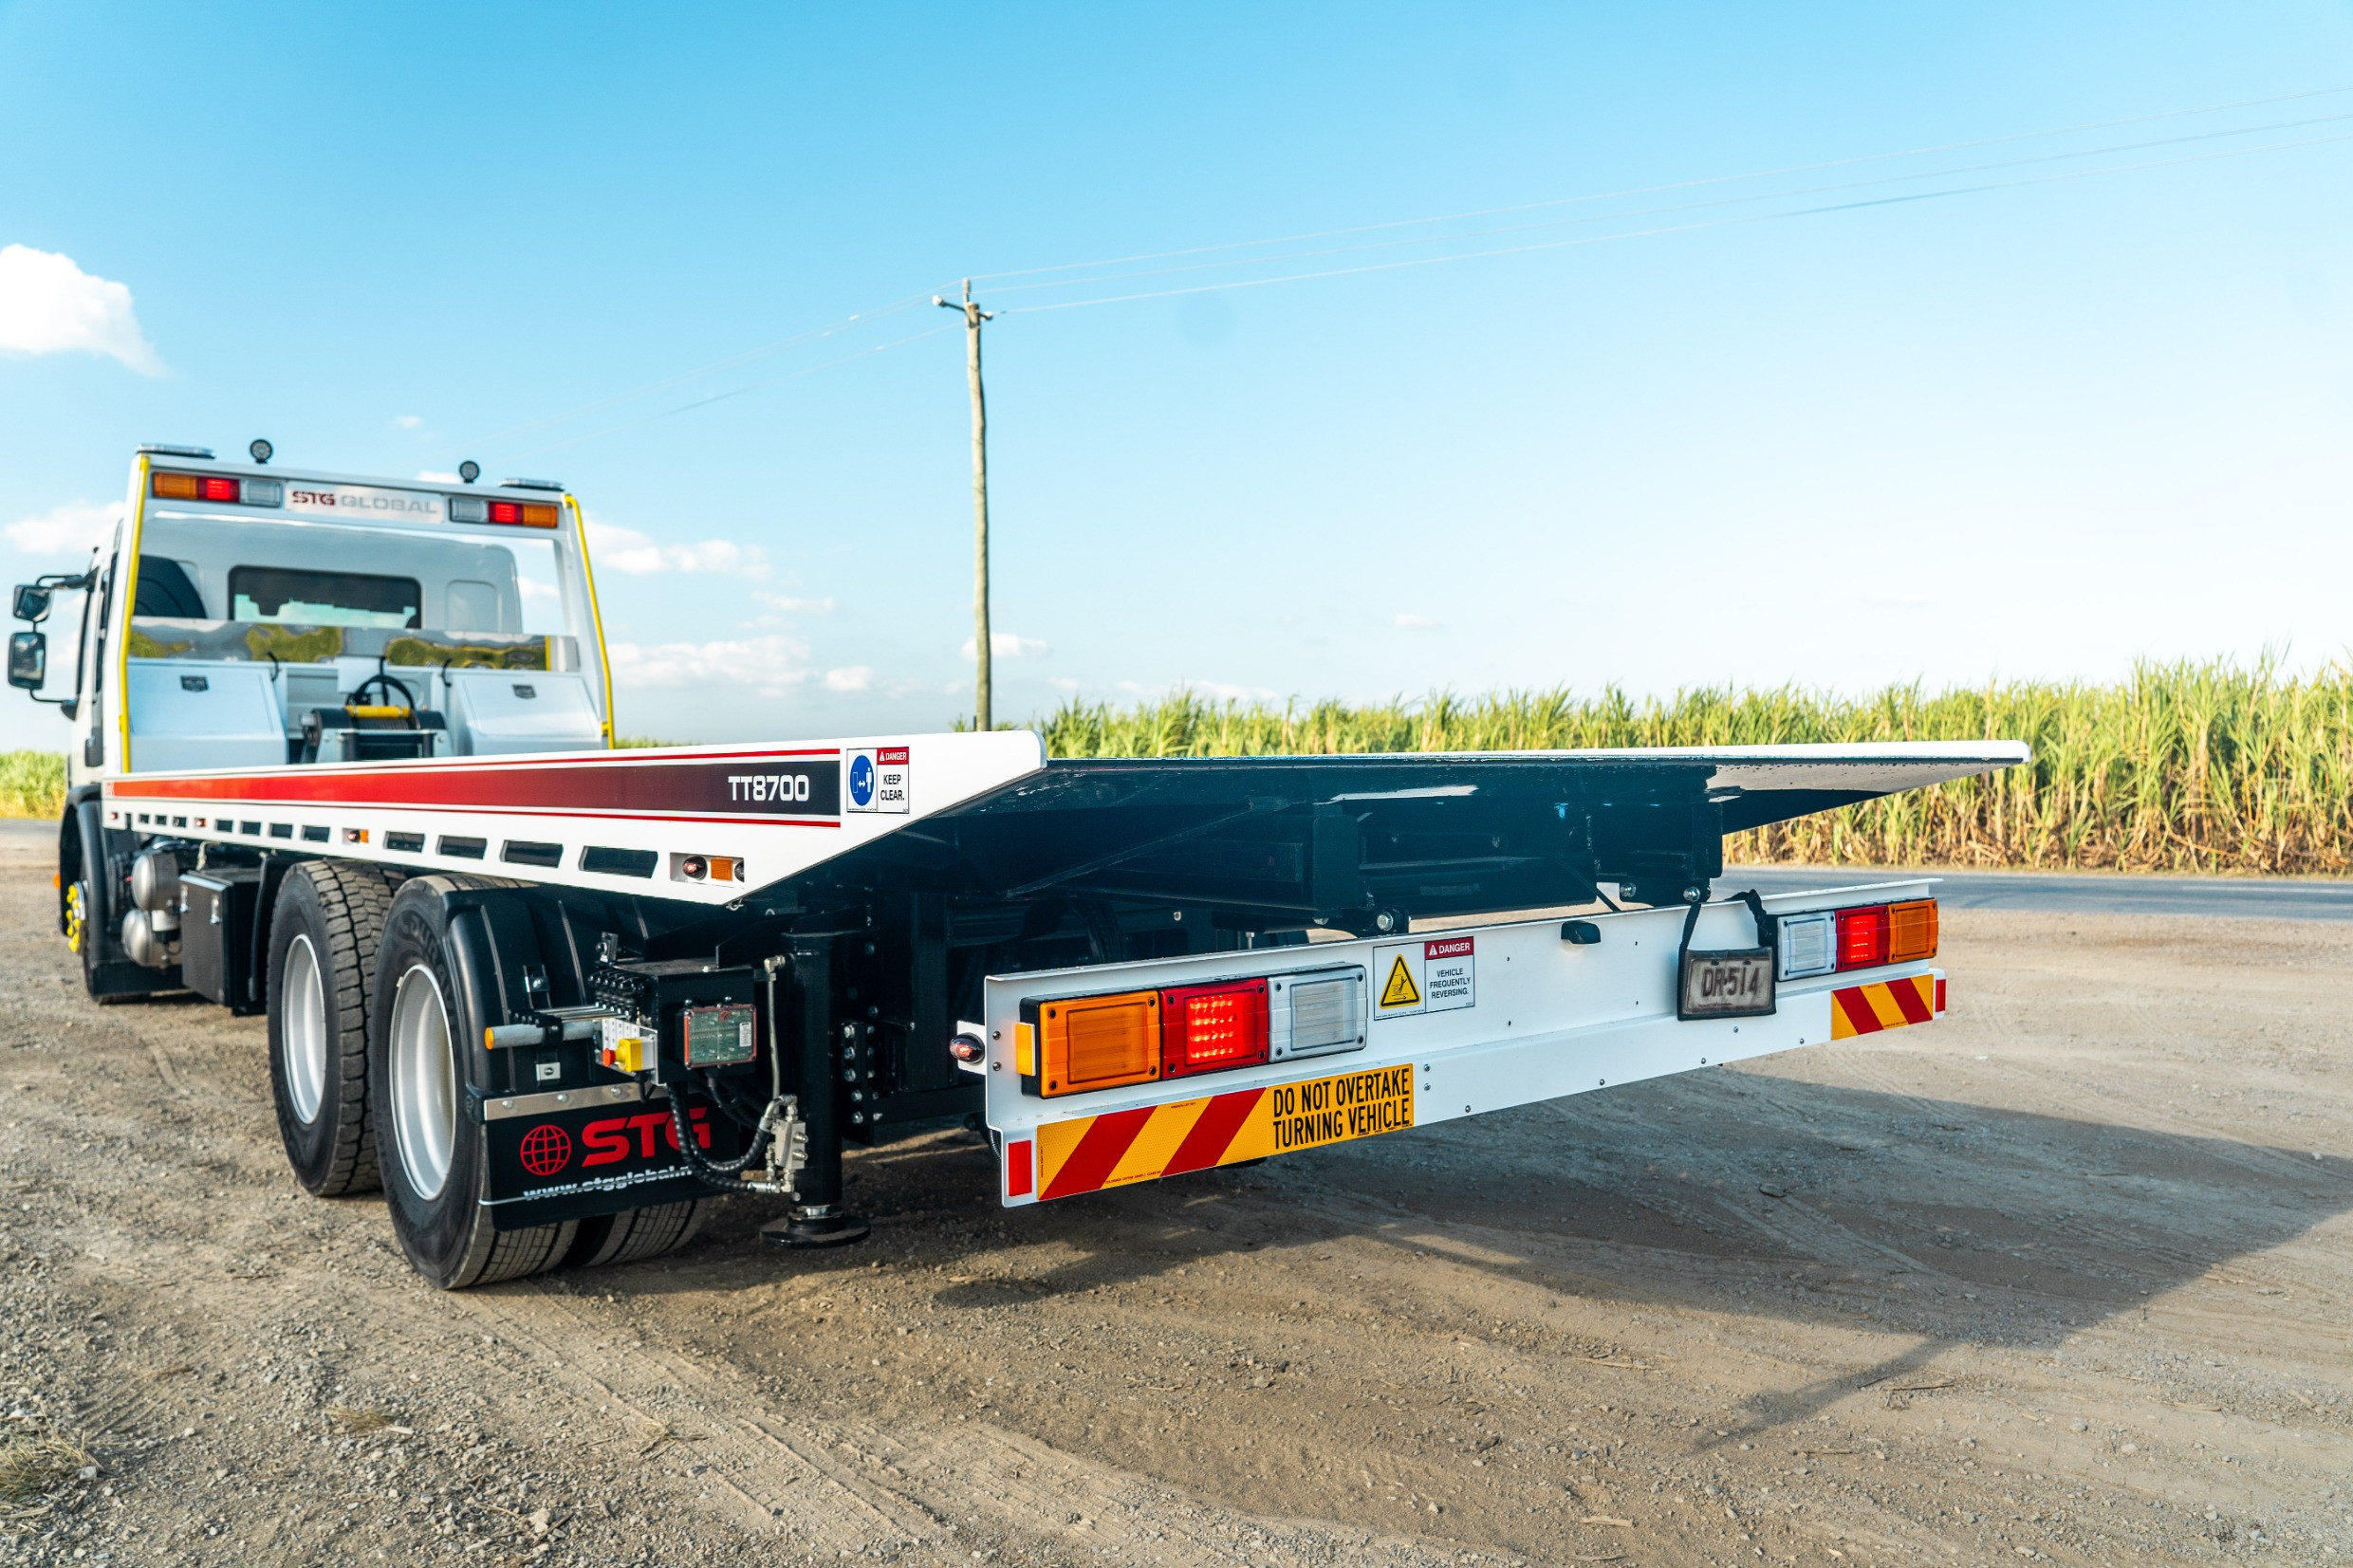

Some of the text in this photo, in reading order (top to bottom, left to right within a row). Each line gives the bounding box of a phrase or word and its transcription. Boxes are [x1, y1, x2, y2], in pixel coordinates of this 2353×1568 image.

[292, 490, 436, 513] STG GLOBAL
[885, 751, 907, 761] DANGER
[883, 774, 901, 784] KEEP
[728, 774, 809, 802] TT8700
[880, 789, 905, 801] CLEAR.
[1438, 942, 1471, 954] DANGER
[1436, 968, 1464, 978] VEHICLE
[1429, 977, 1472, 989] FREQUENTLY
[1431, 987, 1470, 1000] REVERSING.
[1273, 1068, 1410, 1118] DO NOT OVERTAKE
[1272, 1098, 1410, 1150] TURNING VEHICLE
[581, 1106, 712, 1168] STG
